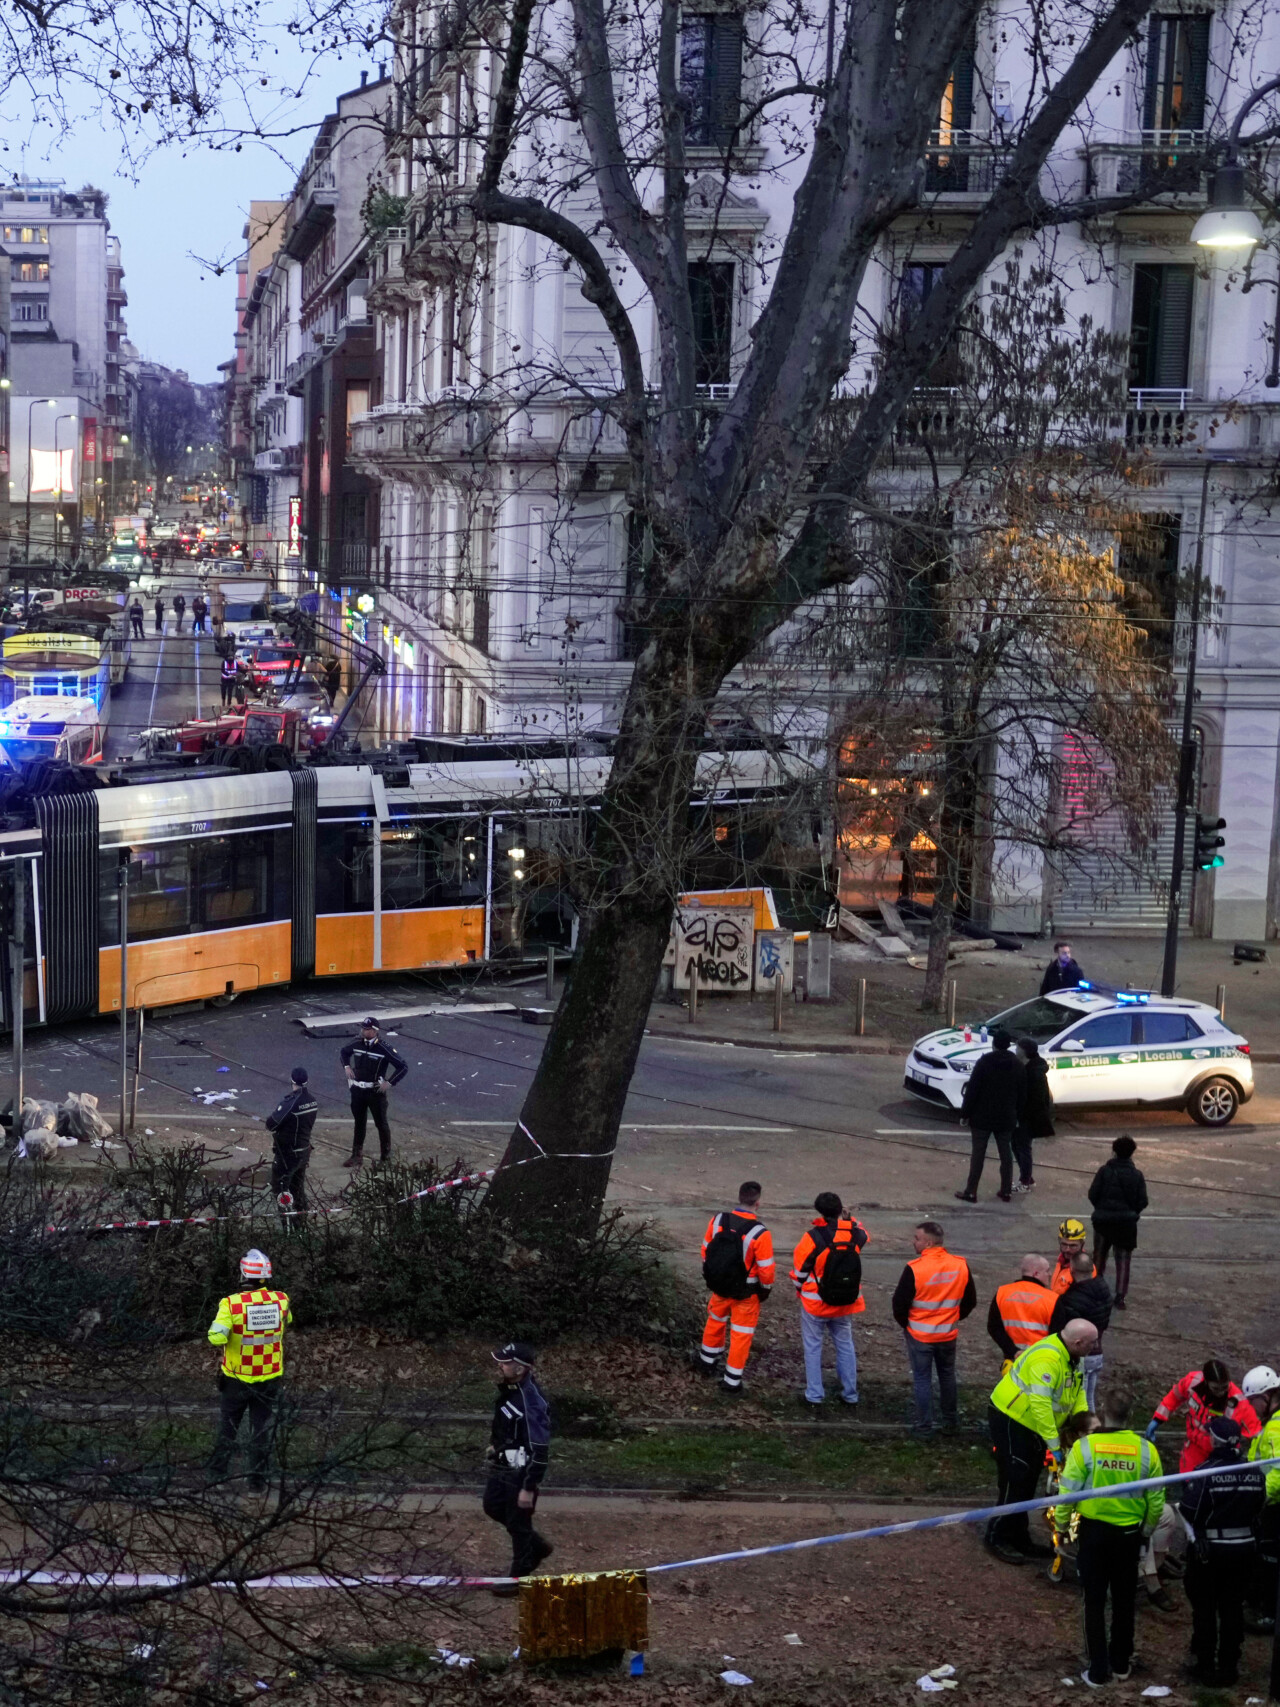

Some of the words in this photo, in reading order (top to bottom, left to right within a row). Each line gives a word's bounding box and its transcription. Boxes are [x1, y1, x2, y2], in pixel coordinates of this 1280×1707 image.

[86, 441, 95, 456] ibis
[26, 637, 72, 647] idealista
[191, 822, 207, 832] 7707
[1071, 1056, 1110, 1068] Polizia
[1144, 1050, 1183, 1062] Locale
[1102, 1460, 1135, 1471] AREU
[1211, 1474, 1237, 1483] POLIZIA
